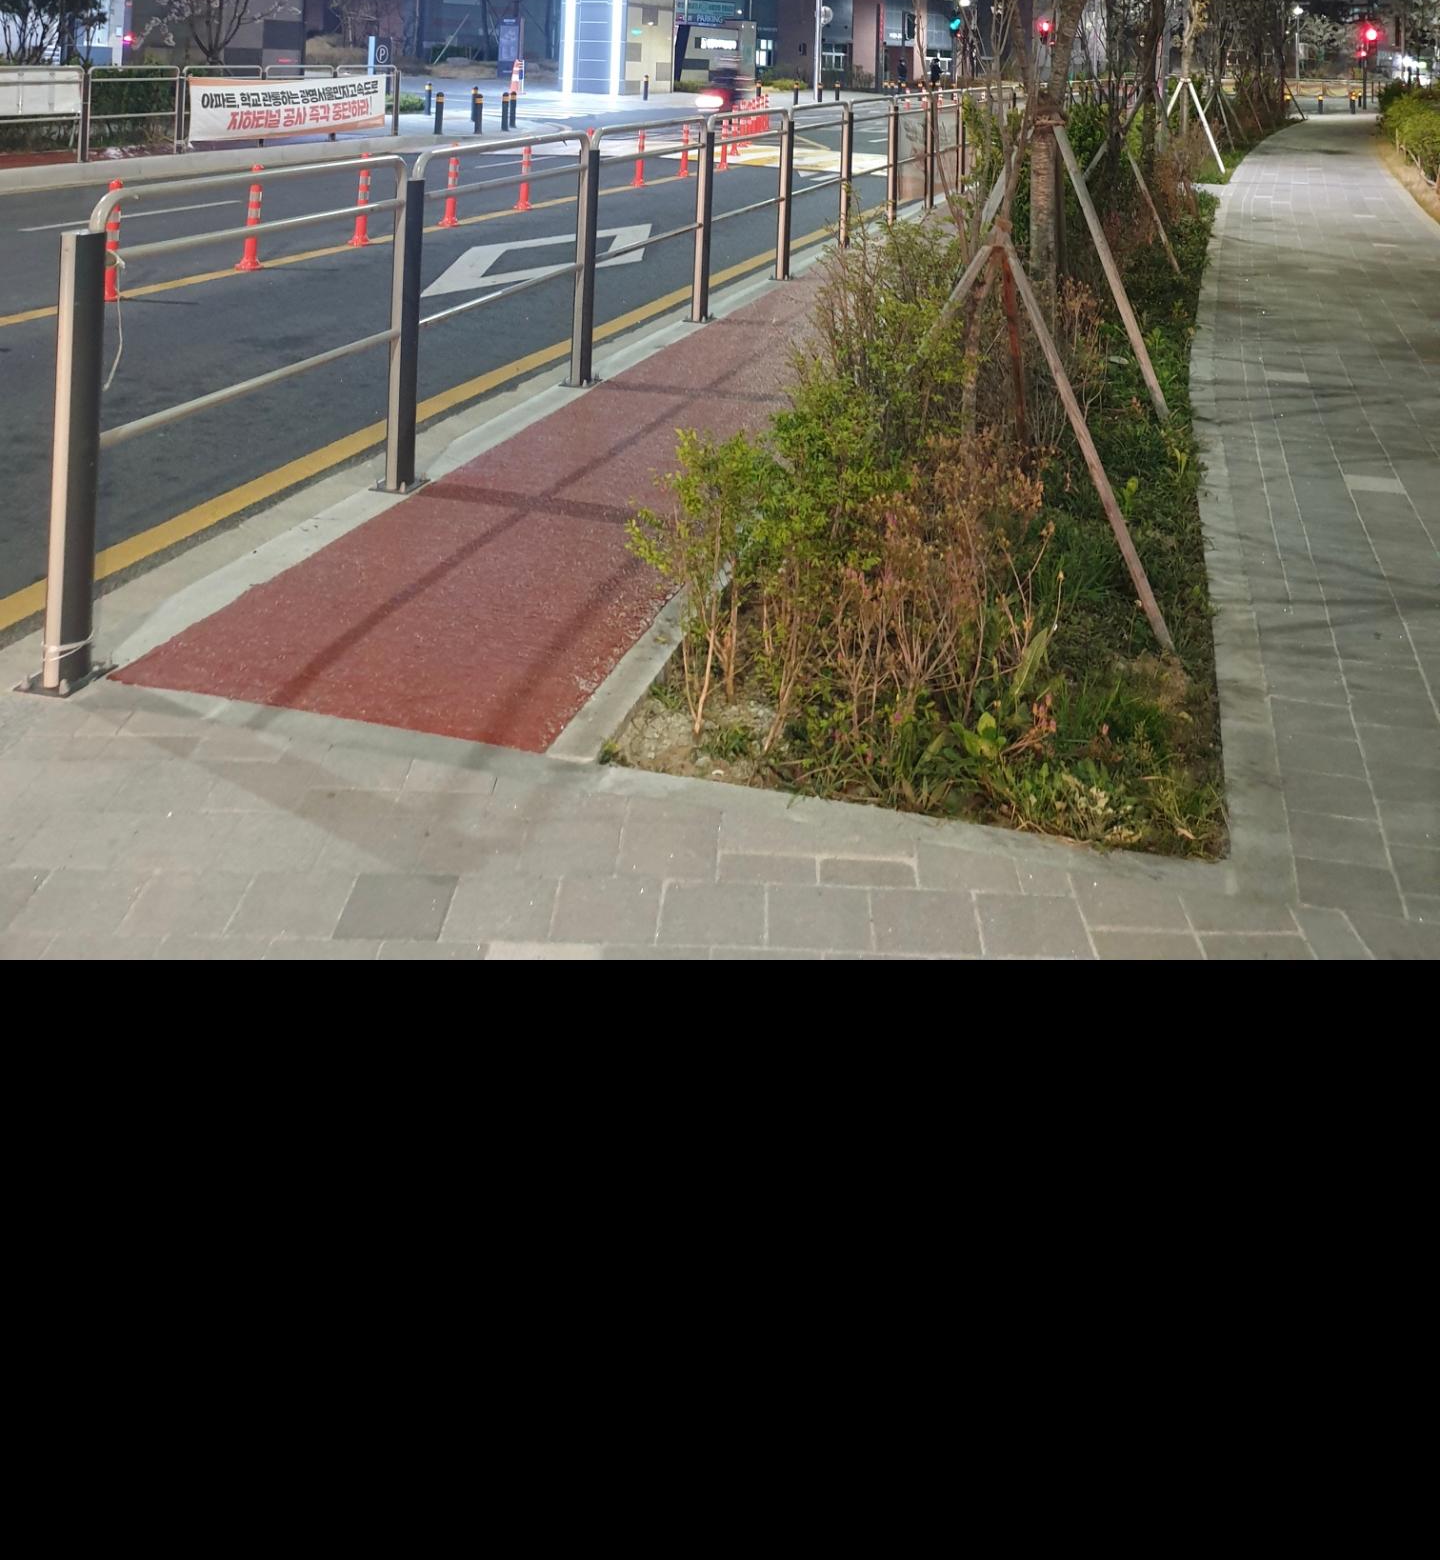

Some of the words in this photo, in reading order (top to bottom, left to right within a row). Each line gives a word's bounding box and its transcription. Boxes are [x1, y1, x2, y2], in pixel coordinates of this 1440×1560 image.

[201, 92, 240, 109] 아파트,
[240, 92, 262, 108] 학교
[227, 109, 281, 130] 지하터널
[283, 106, 307, 127] 공사
[309, 104, 331, 123] 즉각
[332, 95, 372, 121] 중단하라!
